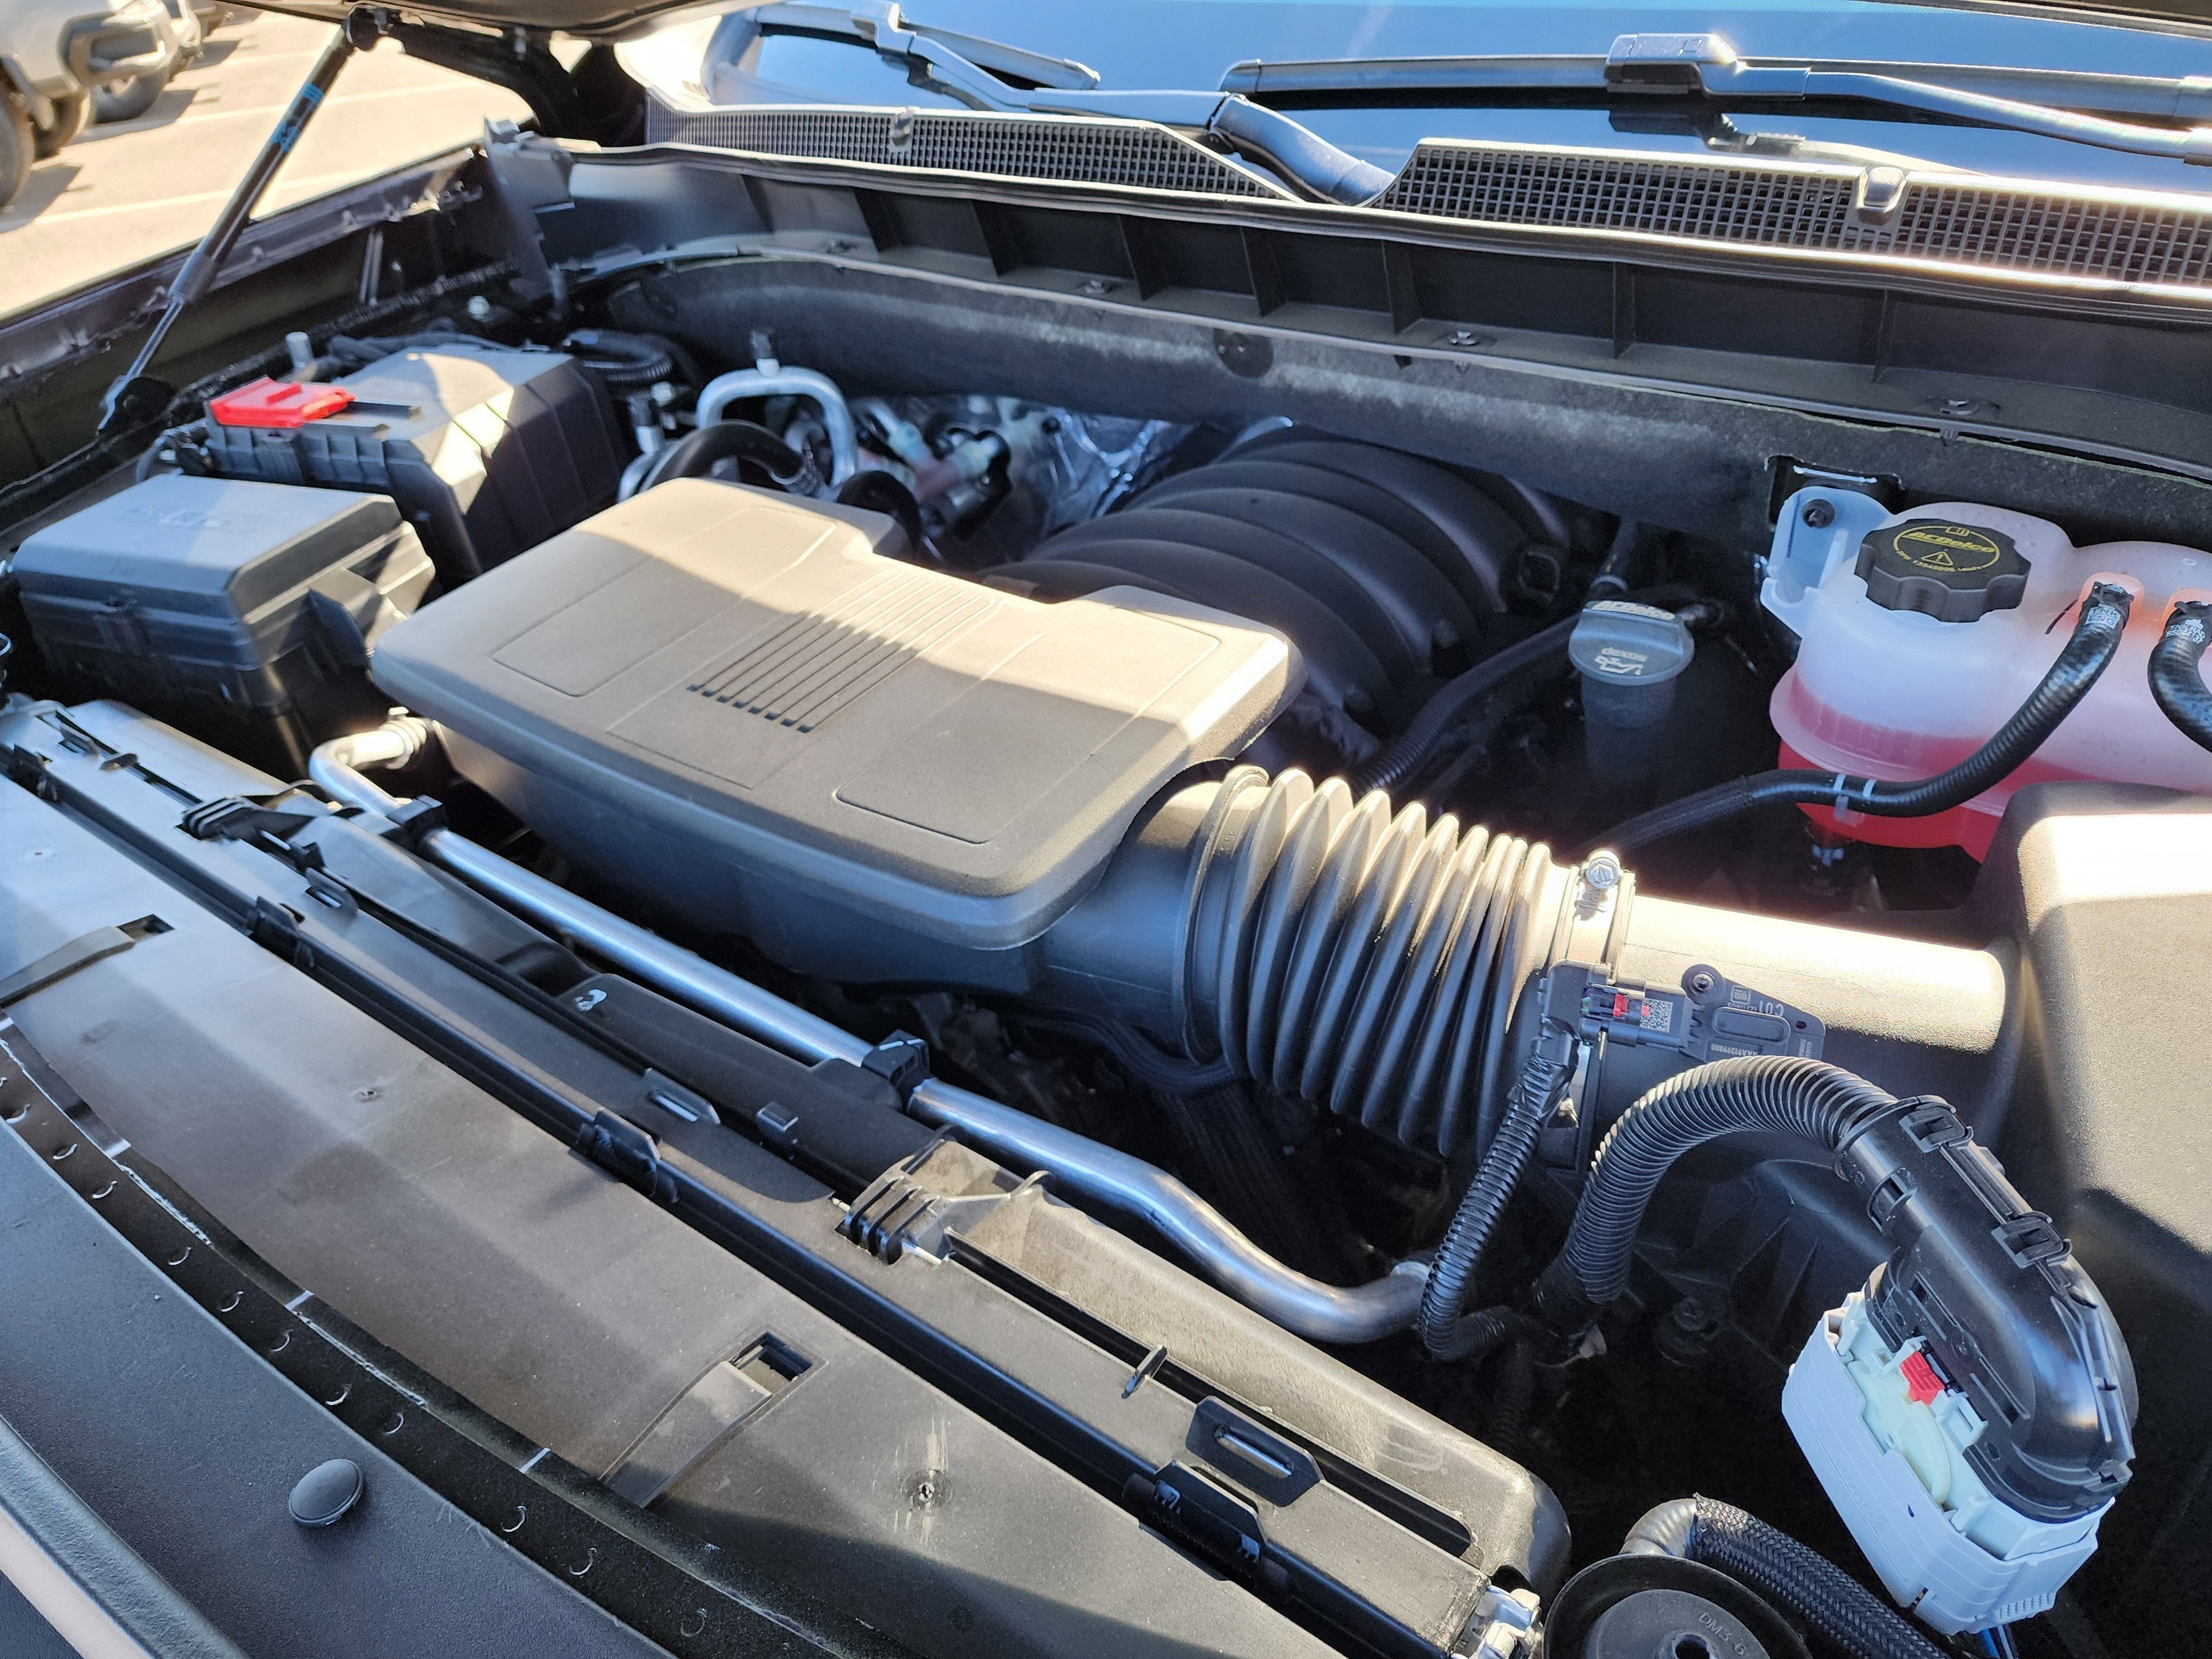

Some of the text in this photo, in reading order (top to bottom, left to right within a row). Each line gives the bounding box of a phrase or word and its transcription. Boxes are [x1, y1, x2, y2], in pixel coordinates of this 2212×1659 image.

[1903, 531, 1996, 553] ACDelco
[1591, 600, 1676, 621] ACDelco
[2092, 607, 2118, 619] TNK
[2089, 615, 2115, 625] ENG
[2189, 626, 2205, 639] RAD
[1600, 646, 1648, 662] dexos
